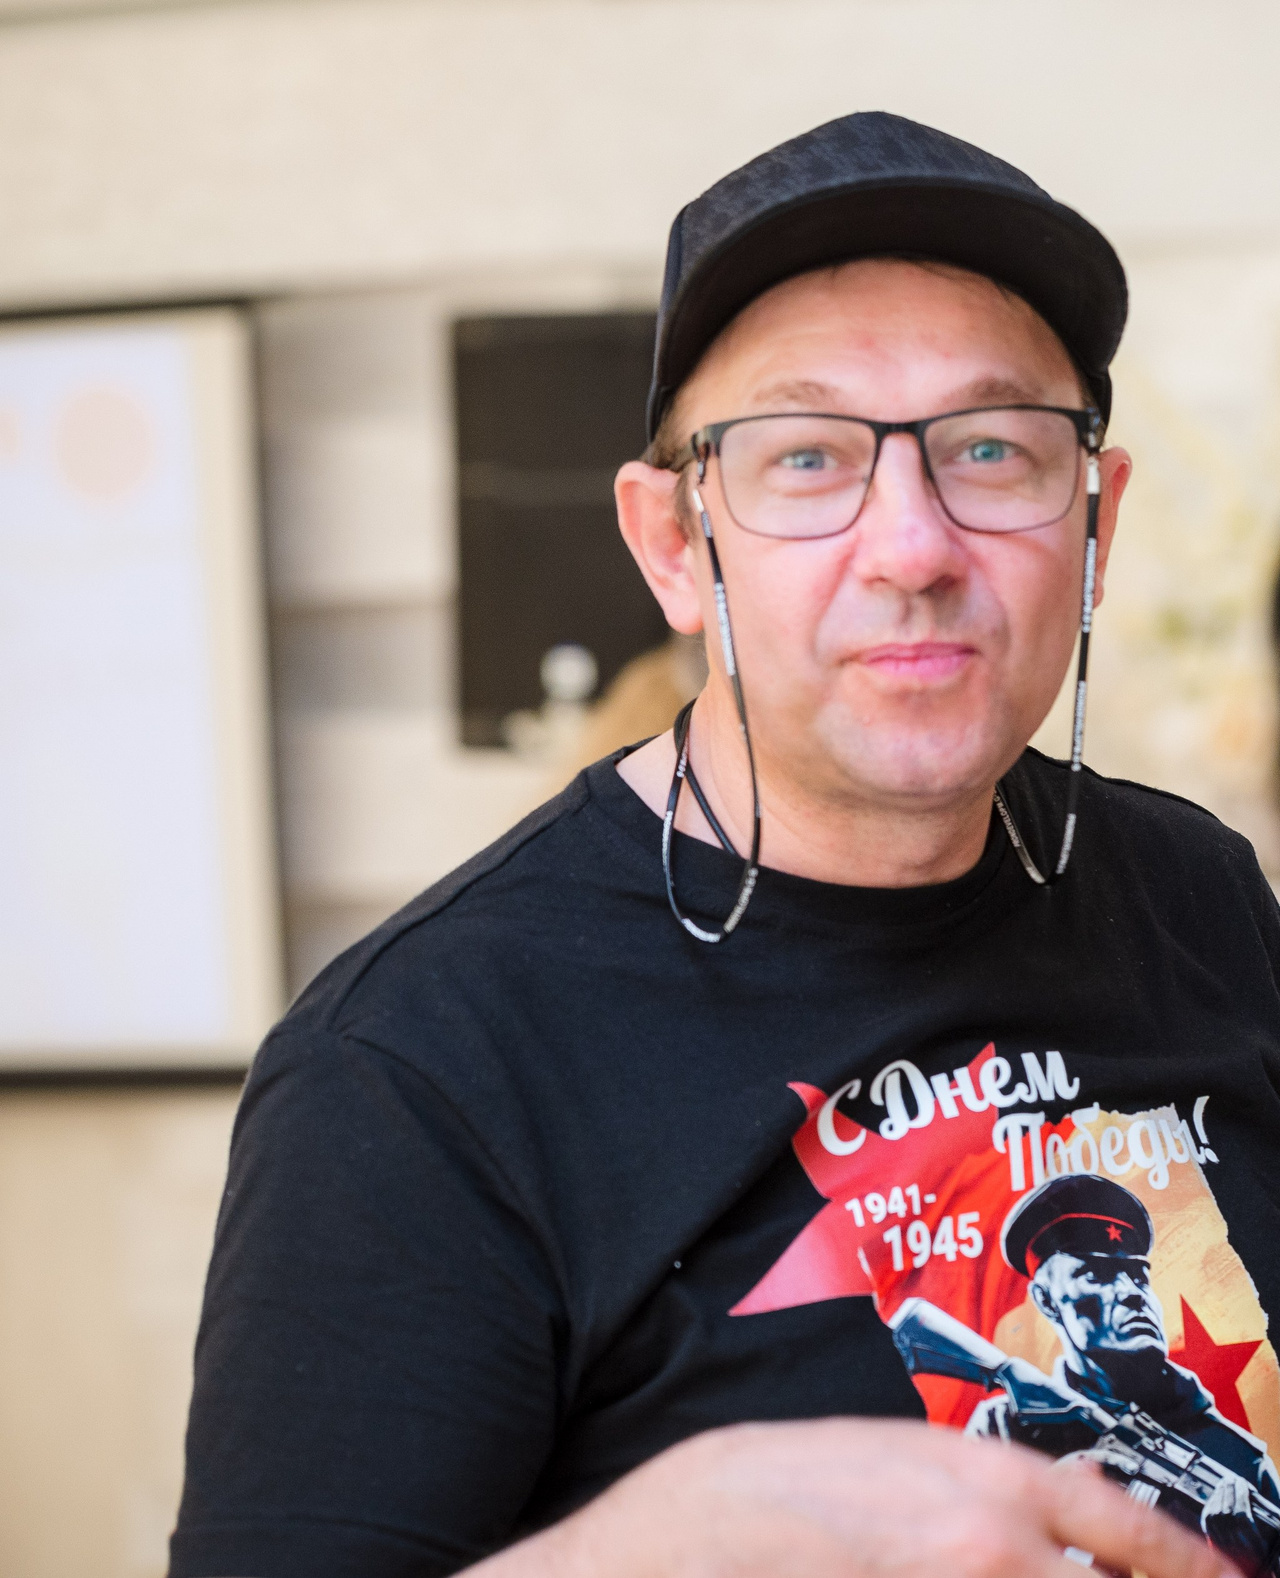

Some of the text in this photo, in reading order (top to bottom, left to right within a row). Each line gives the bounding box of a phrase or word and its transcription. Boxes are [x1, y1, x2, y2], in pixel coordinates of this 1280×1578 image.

[817, 1050, 1080, 1156] С Днем
[992, 1095, 1219, 1191] Победы!
[845, 1183, 937, 1228] 1941-
[883, 1211, 984, 1272] 1945
